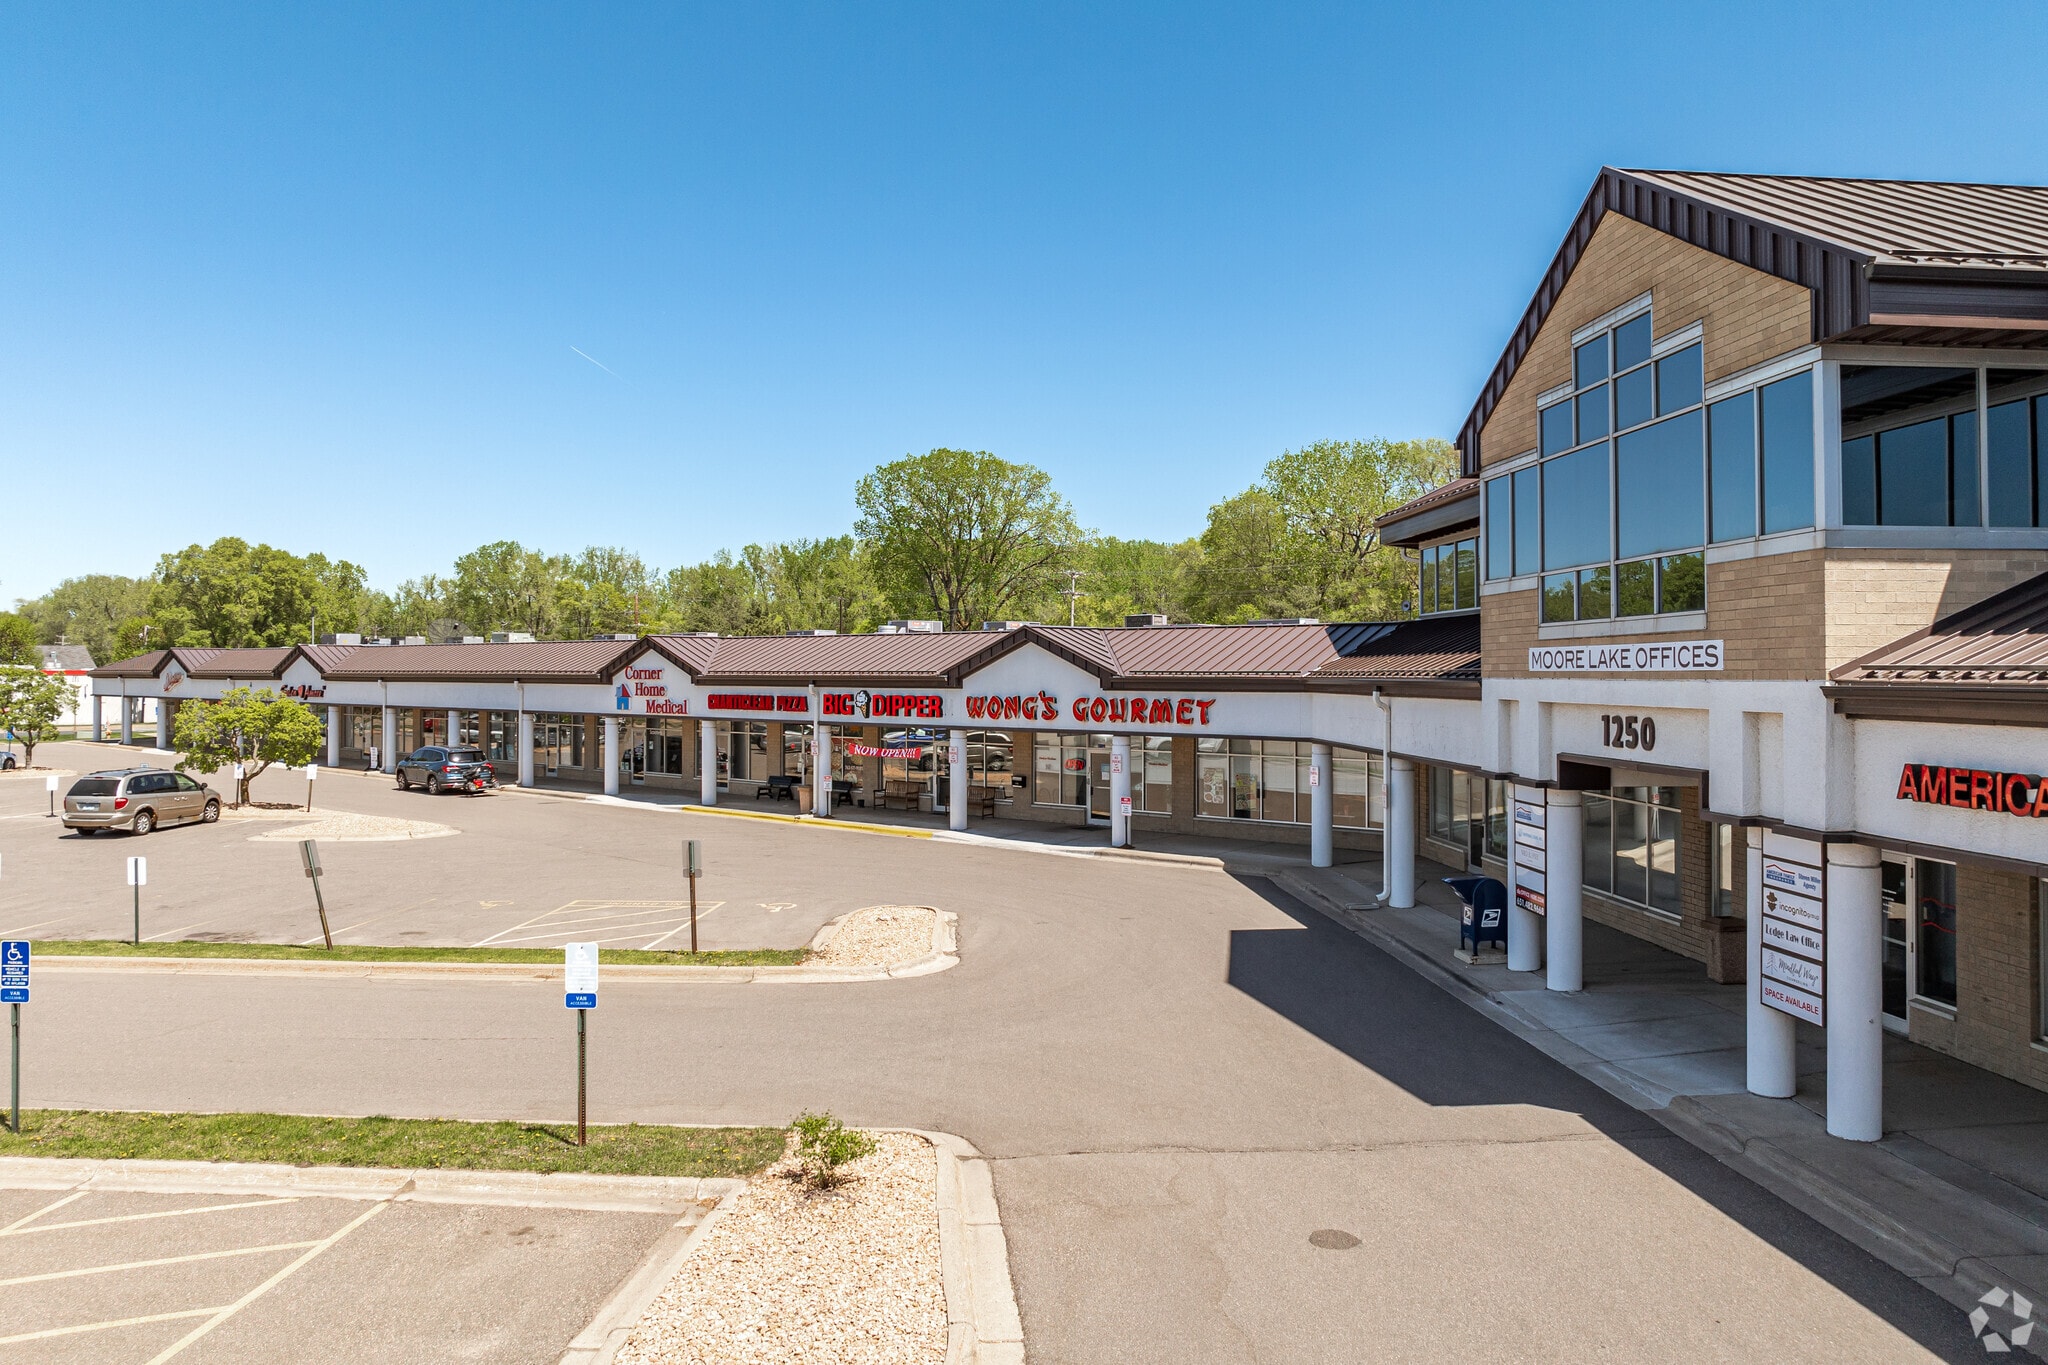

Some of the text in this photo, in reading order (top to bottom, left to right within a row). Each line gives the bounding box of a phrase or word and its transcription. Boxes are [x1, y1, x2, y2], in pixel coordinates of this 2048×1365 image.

[1531, 644, 1719, 669] MOORE LAKE OFFICES
[625, 666, 662, 680] Corner
[635, 682, 665, 697] Home
[645, 699, 688, 715] Medical
[776, 695, 808, 712] PIZZA
[823, 693, 943, 718] BIG DIPPER
[965, 690, 1217, 725] WONG'S GOURMET
[1601, 714, 1656, 751] 1250
[854, 745, 916, 758] NOW OPEN!!!
[1065, 759, 1085, 771] OPEN
[1896, 763, 2048, 818] AMERICA
[1765, 924, 1820, 950] Lodge Law Office
[1764, 987, 1819, 1015] SPACE AVAILABLE
